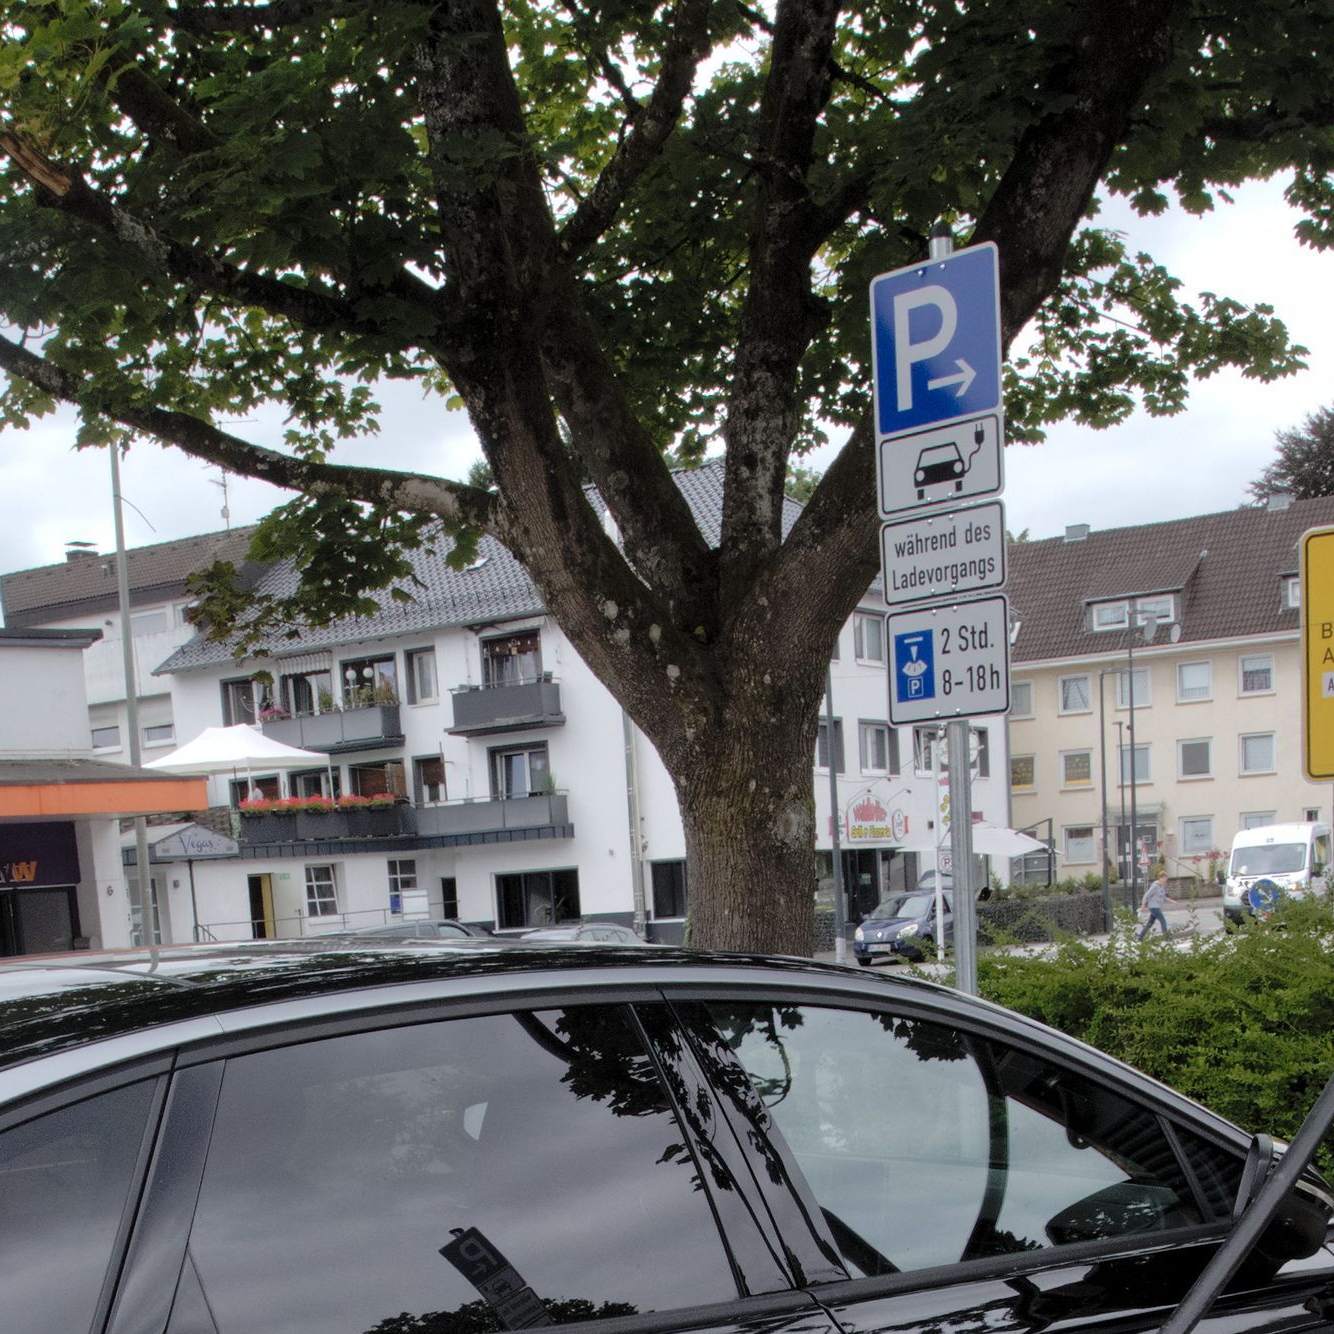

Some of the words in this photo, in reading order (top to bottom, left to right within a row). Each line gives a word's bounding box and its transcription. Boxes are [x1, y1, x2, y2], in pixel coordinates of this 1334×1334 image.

[894, 285, 958, 412] P
[894, 525, 956, 559] während
[964, 521, 991, 545] des
[892, 556, 995, 591] Ladevorgangs
[941, 627, 951, 655] 2
[958, 621, 994, 652] Std.
[178, 834, 214, 854] Vegas
